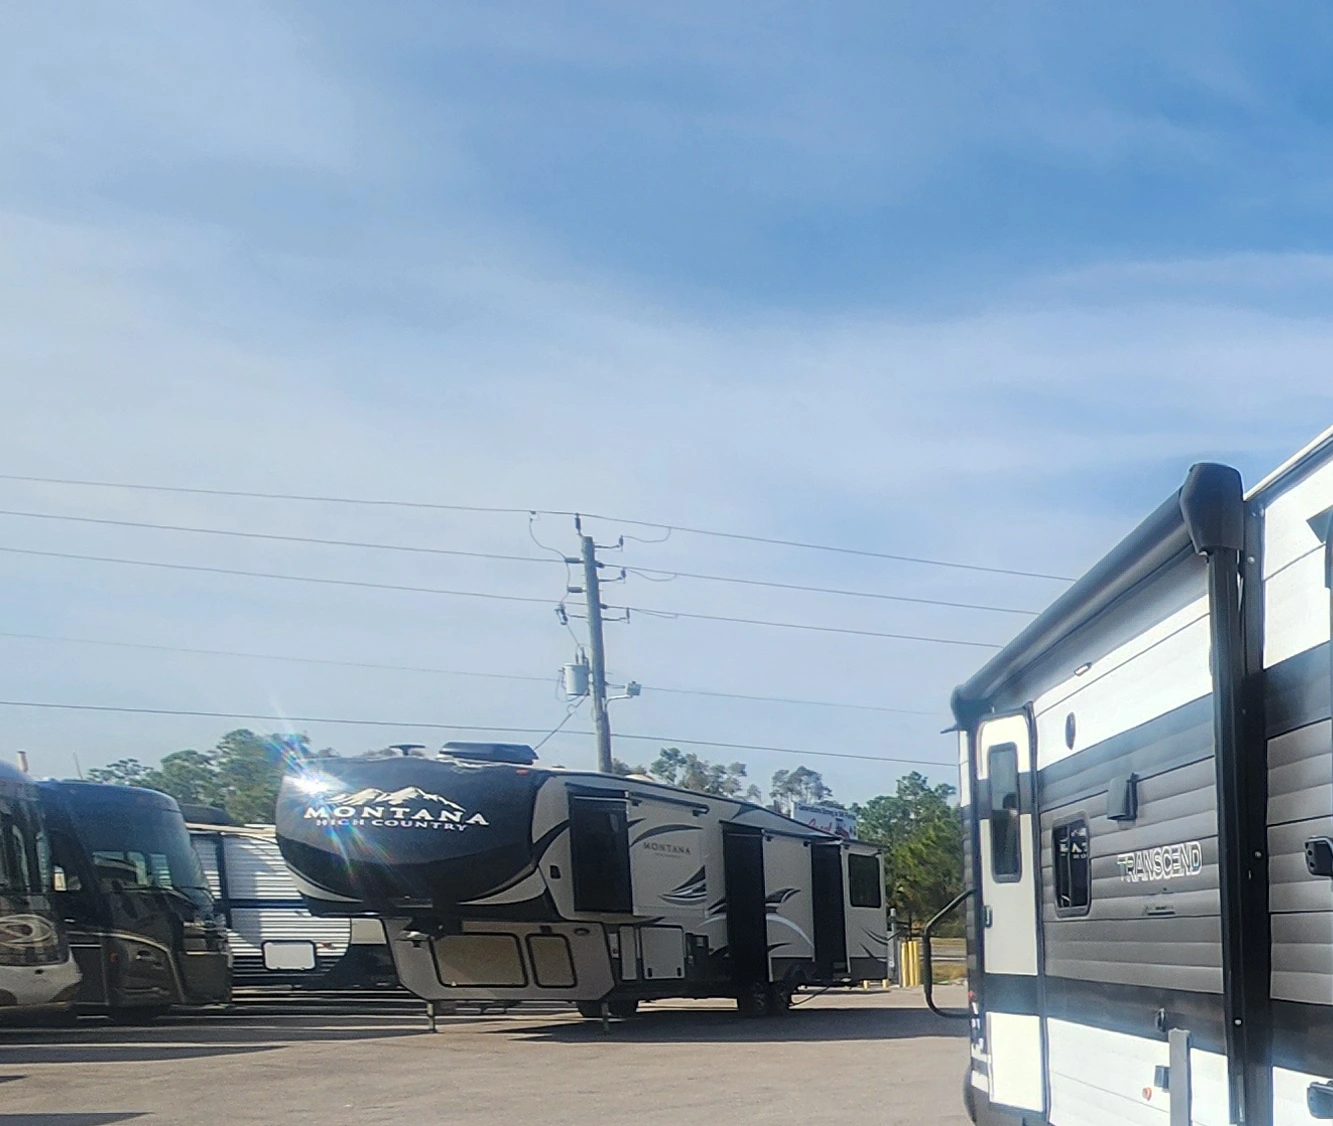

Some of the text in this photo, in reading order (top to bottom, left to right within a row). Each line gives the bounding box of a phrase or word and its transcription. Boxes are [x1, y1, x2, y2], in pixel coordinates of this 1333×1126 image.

[303, 805, 490, 826] MONTANA
[371, 818, 468, 832] COUNTRY
[643, 841, 692, 855] MONTANA
[1116, 840, 1203, 883] TRANSCEND
